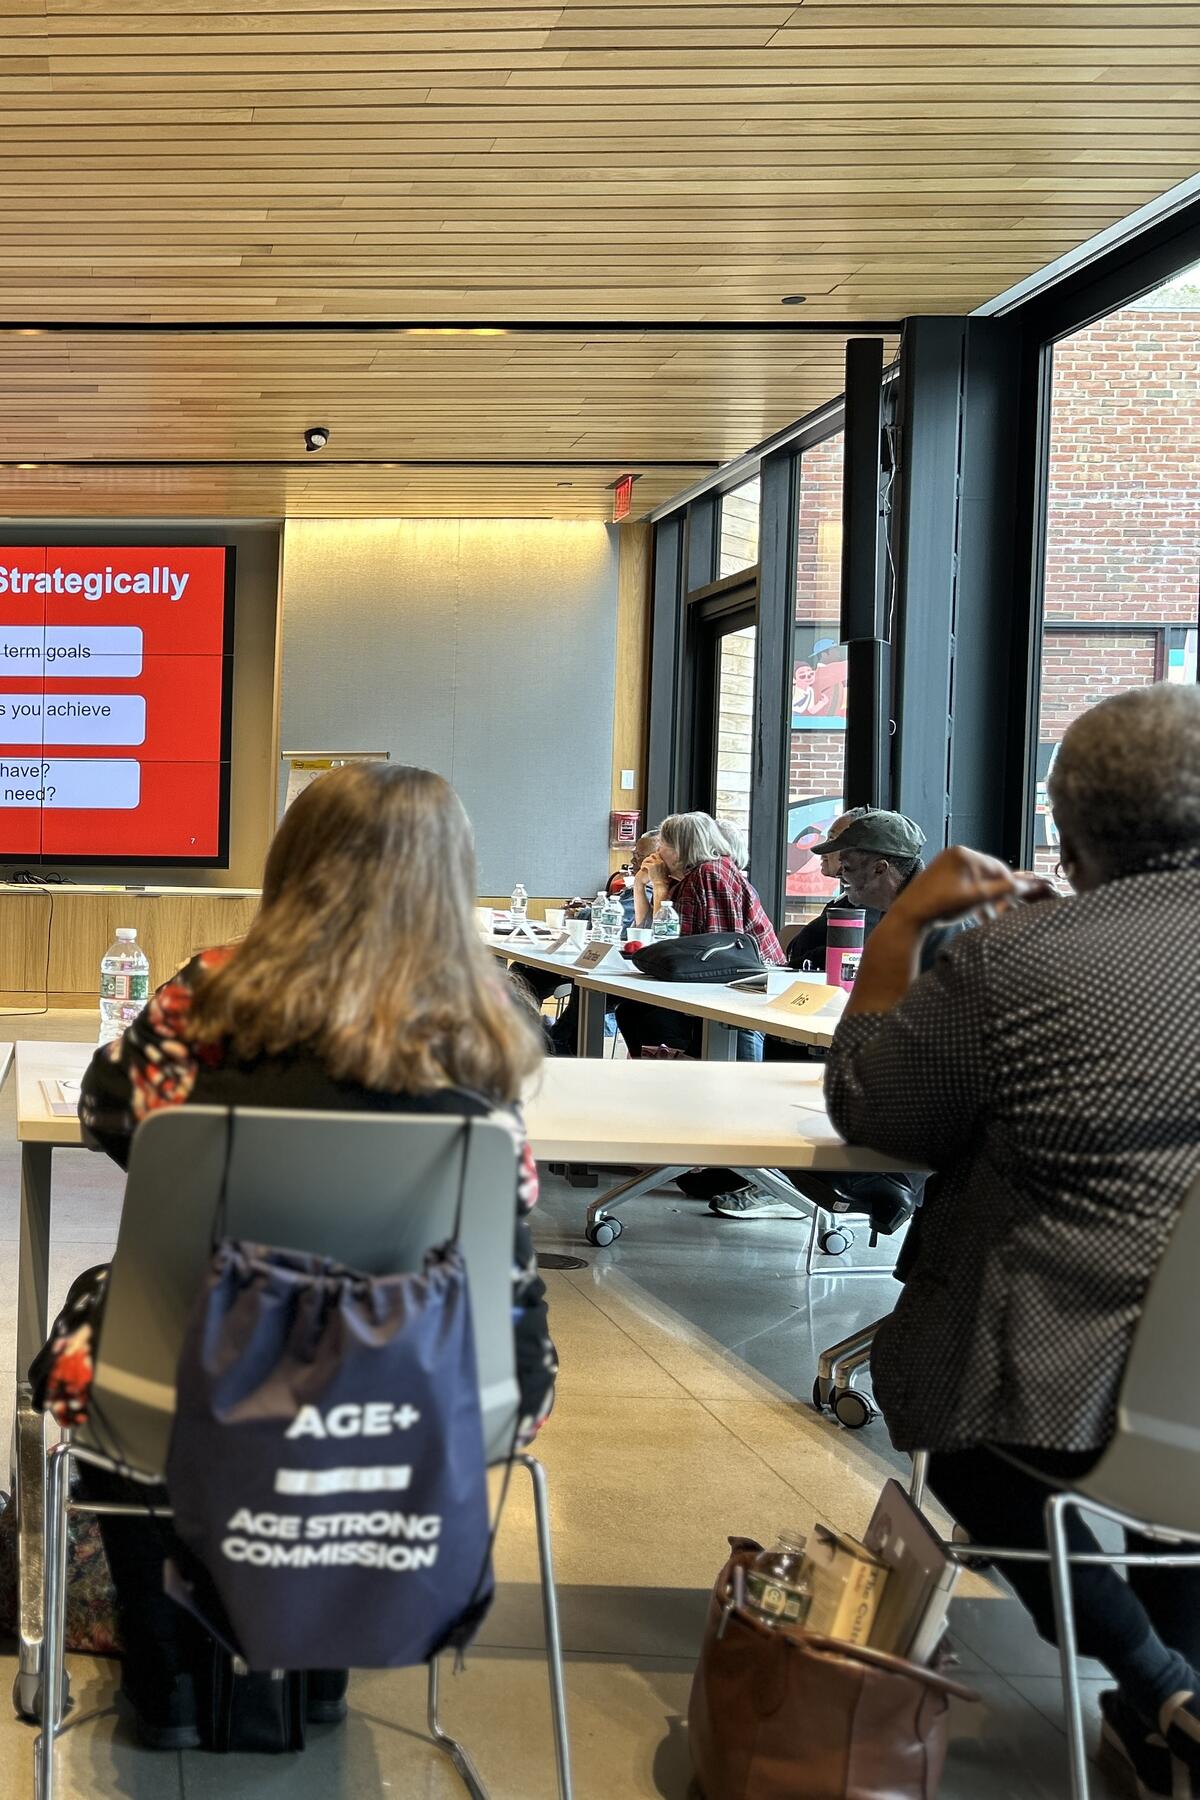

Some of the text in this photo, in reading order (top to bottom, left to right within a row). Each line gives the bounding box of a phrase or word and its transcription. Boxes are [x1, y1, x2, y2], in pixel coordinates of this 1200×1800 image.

[4, 643, 41, 658] term
[46, 643, 91, 662] goals
[12, 704, 41, 719] you
[47, 701, 111, 716] achieve
[0, 763, 50, 778] have?
[4, 786, 56, 801] need?
[286, 1402, 420, 1439] AGE+
[227, 1508, 442, 1541] AGE STRONG
[222, 1537, 439, 1571] COMMISSION
